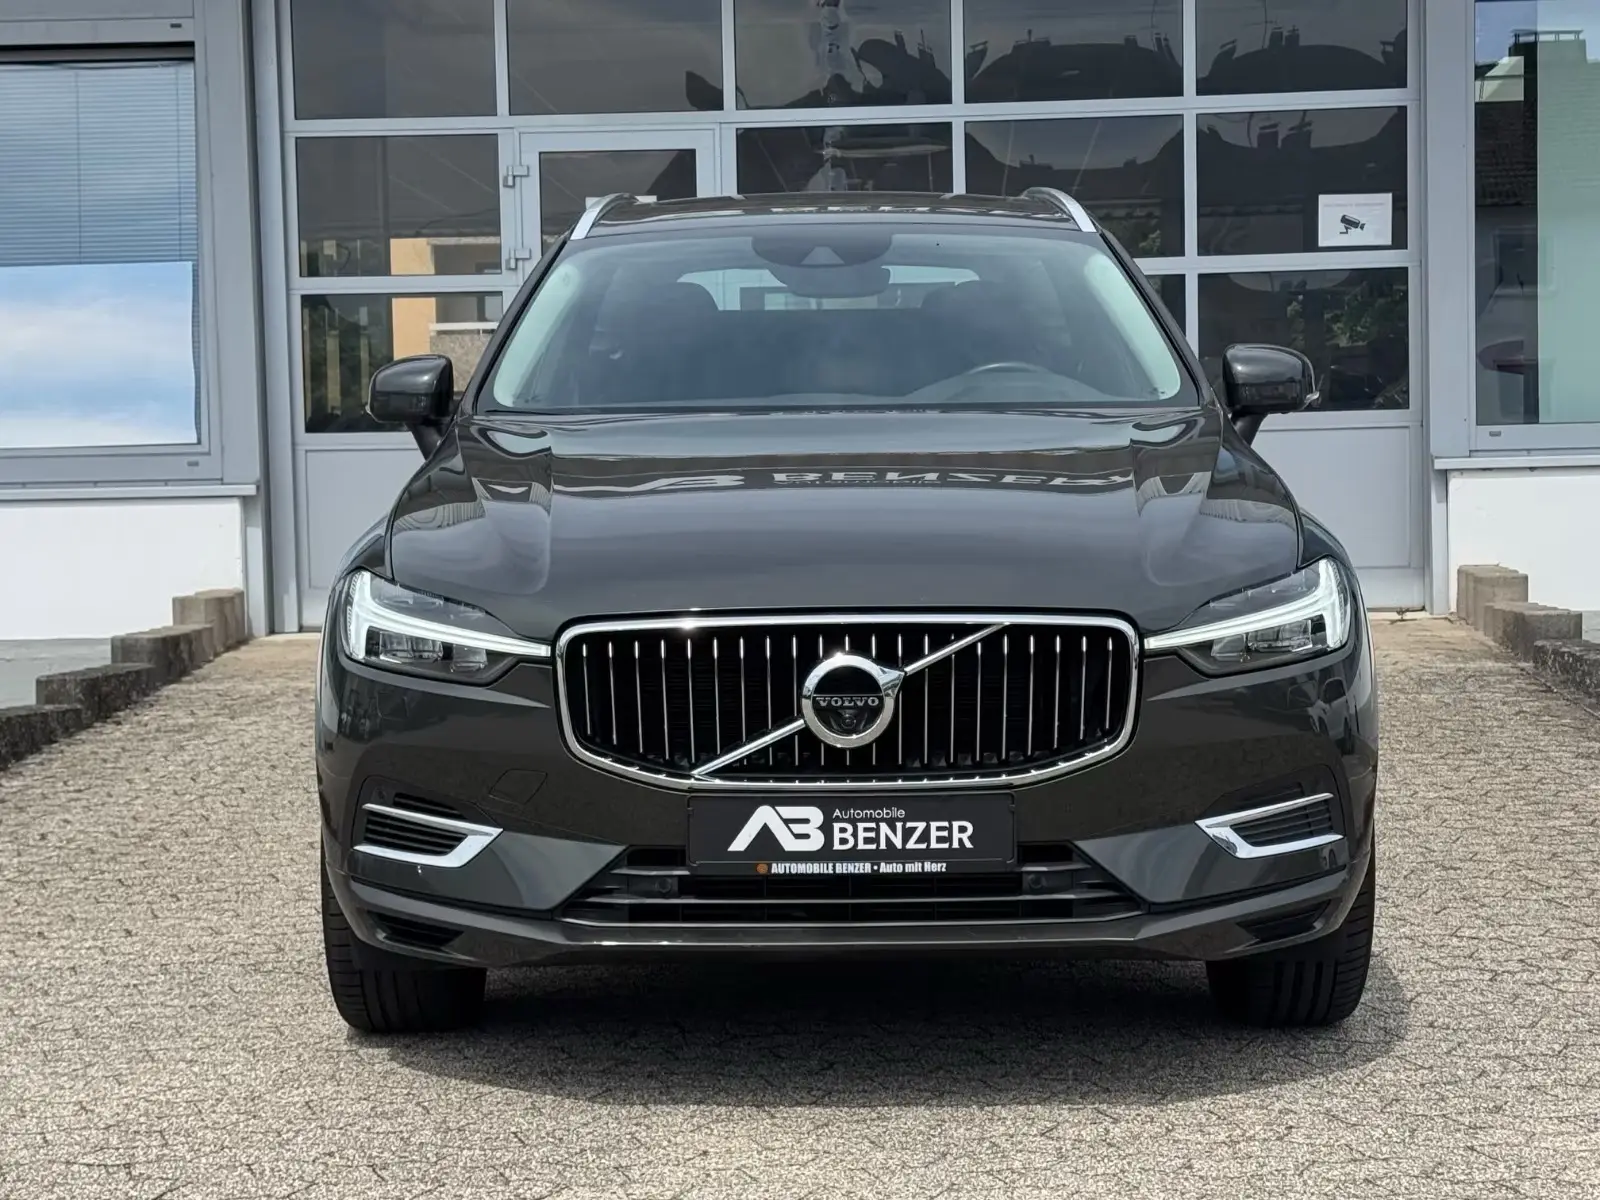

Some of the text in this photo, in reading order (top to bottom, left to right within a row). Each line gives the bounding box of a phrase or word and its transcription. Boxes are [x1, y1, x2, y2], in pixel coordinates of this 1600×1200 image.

[816, 697, 879, 706] VOLVO
[832, 807, 905, 819] Automobile
[832, 821, 974, 850] BENZER
[771, 862, 947, 874] AUTOMOBILE BENZER Auto mit Herz
